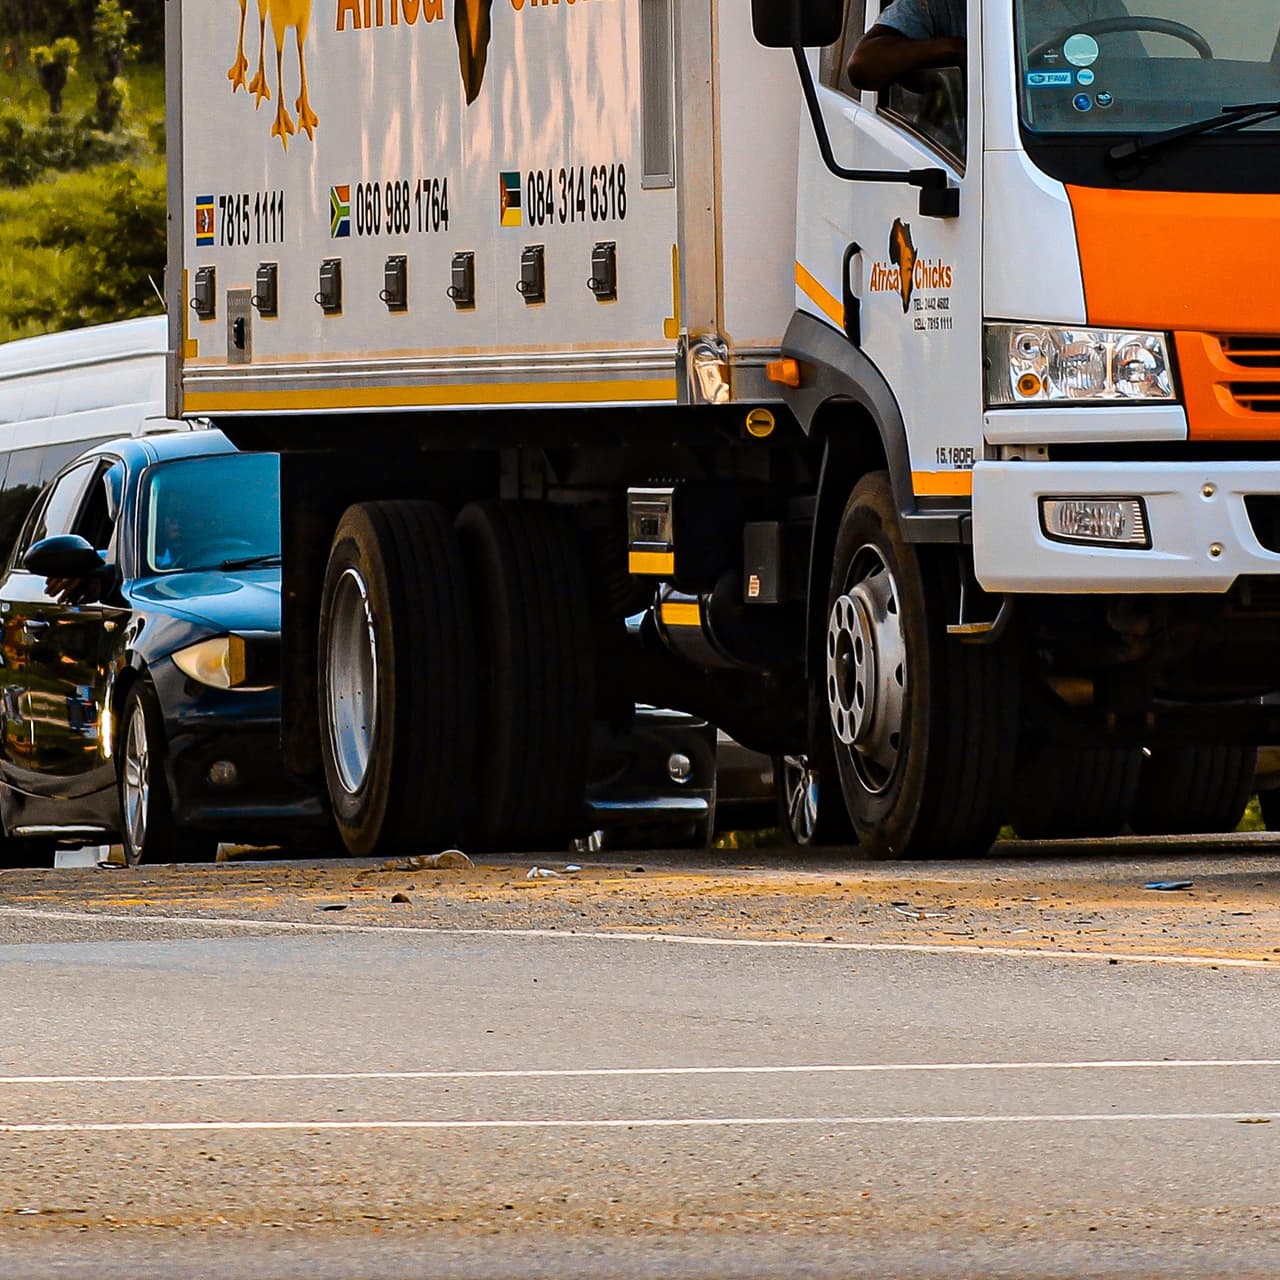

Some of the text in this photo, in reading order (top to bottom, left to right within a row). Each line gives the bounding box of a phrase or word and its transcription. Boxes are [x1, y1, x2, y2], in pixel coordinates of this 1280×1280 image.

[219, 190, 284, 246] 7815 1111
[356, 177, 449, 236] 060 988 1764
[527, 163, 627, 227] 084 314 6318
[870, 258, 952, 292] Africa Chicks
[935, 447, 976, 465] 15.180FL
